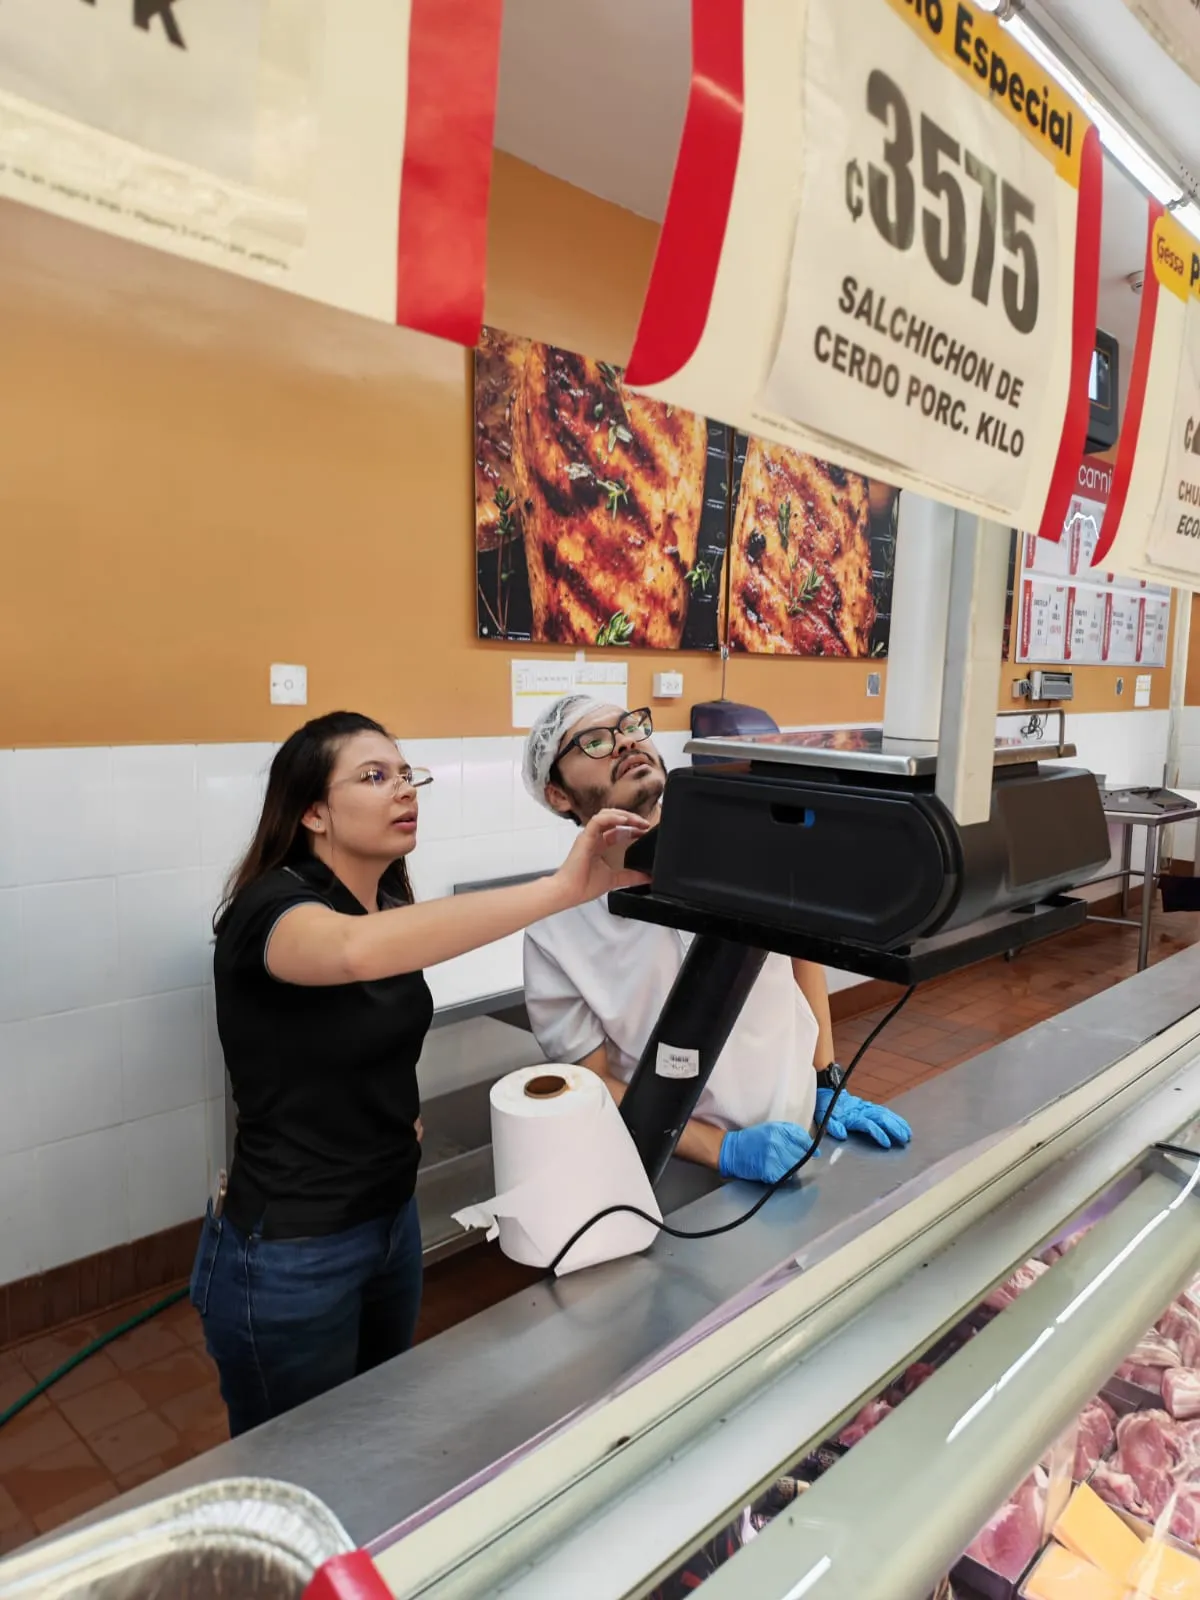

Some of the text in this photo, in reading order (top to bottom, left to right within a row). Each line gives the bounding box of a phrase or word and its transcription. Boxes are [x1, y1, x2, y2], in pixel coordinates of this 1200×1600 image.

[954, 2, 1073, 157] Especial
[813, 325, 900, 399] CERDO
[905, 373, 969, 436] PORC.
[975, 411, 1025, 458] KILO
[838, 275, 1025, 409] SALCHICHON DE
[1176, 513, 1200, 541] ECO
[1178, 479, 1200, 508] CHU
